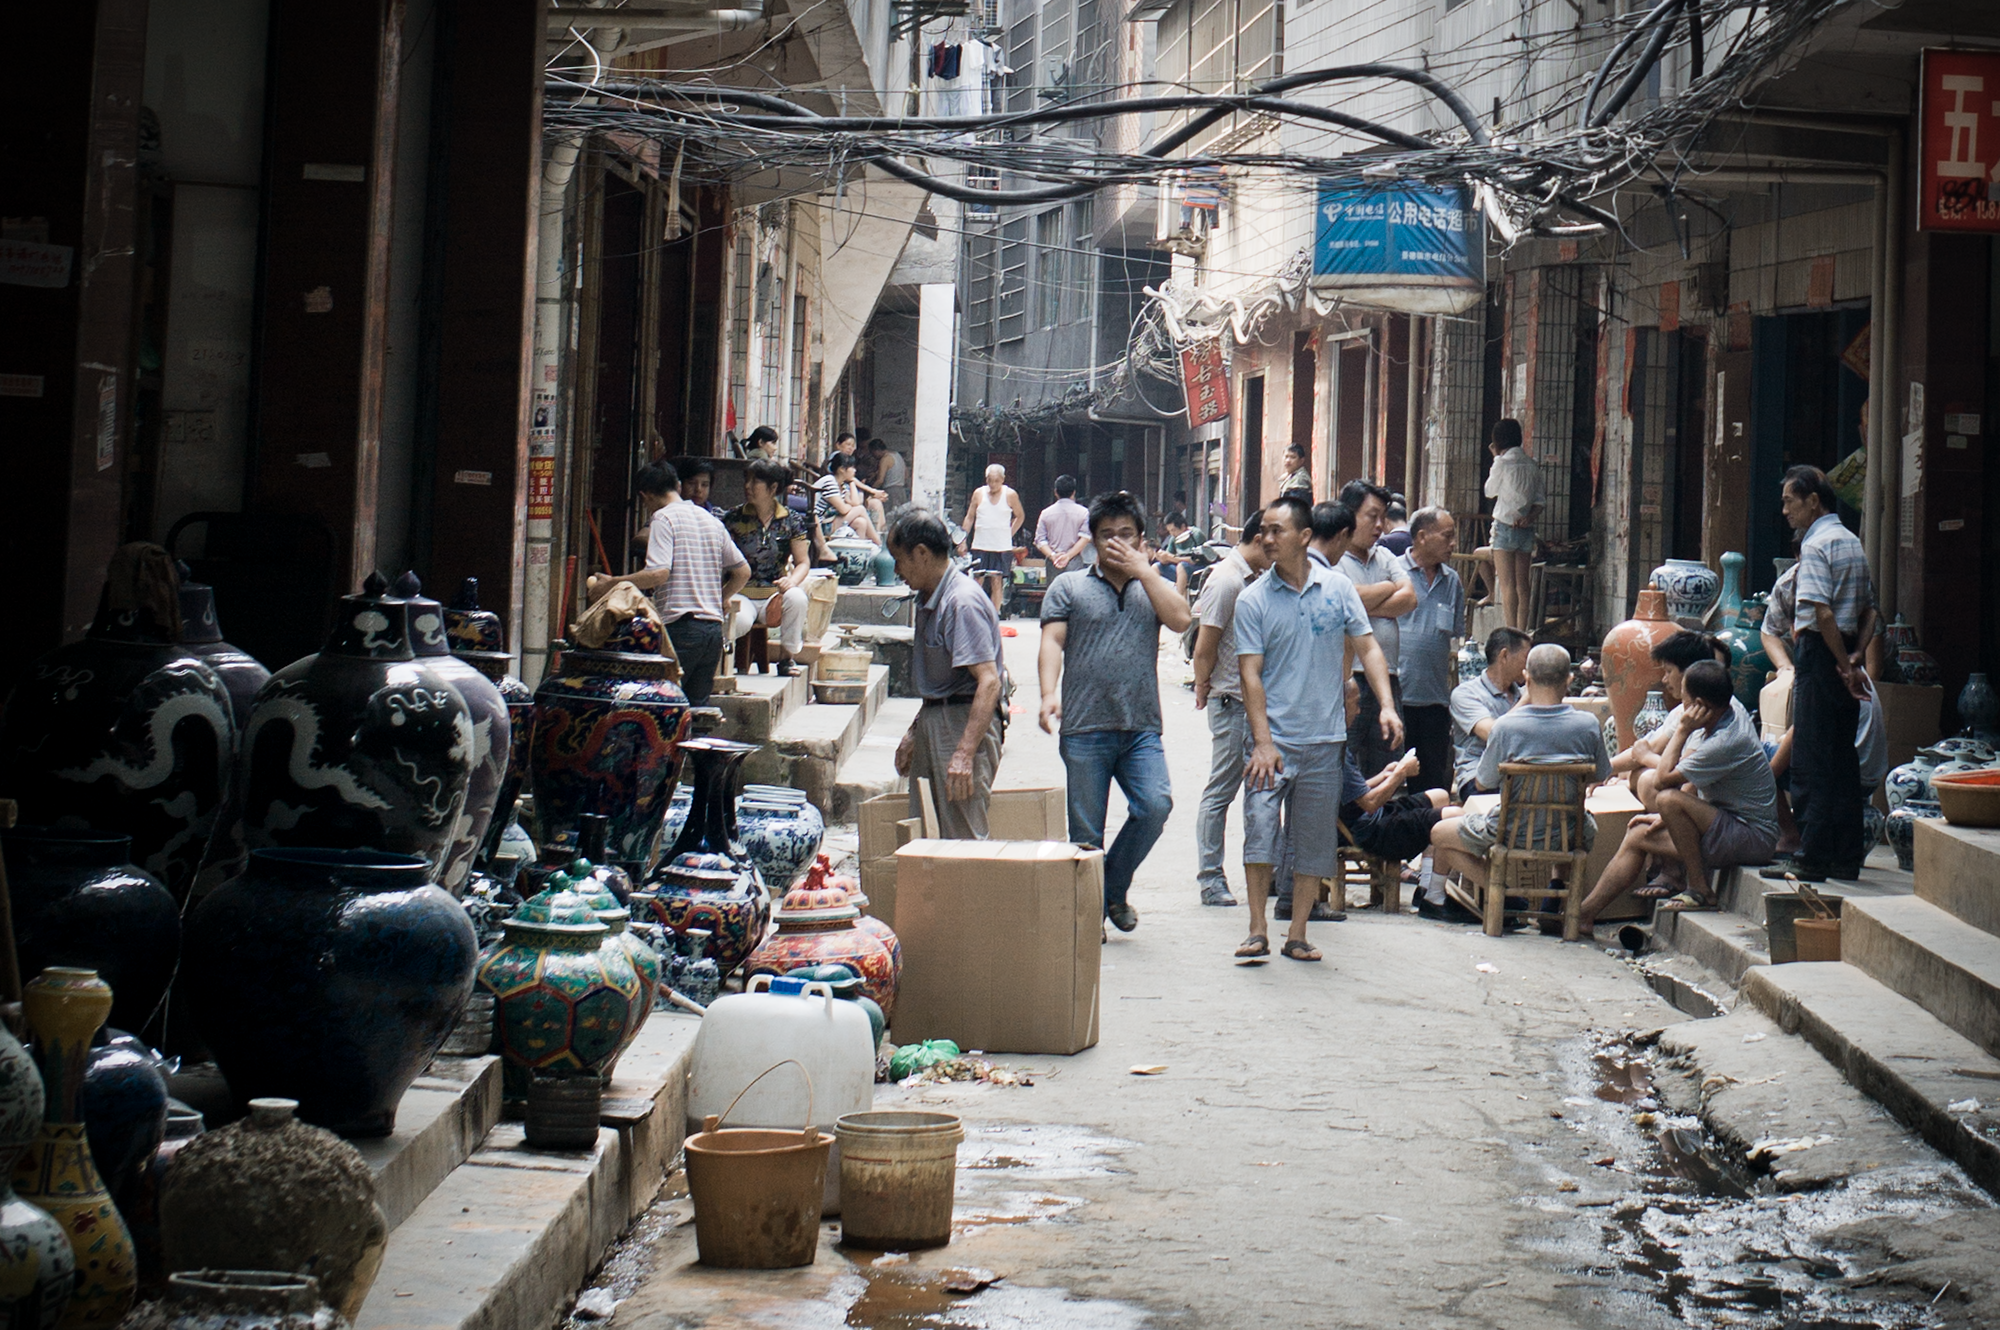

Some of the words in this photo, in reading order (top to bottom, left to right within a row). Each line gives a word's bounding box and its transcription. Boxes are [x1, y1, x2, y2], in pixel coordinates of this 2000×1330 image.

[1937, 75, 2000, 182] 五
[1387, 201, 1479, 232] 公用电话超市
